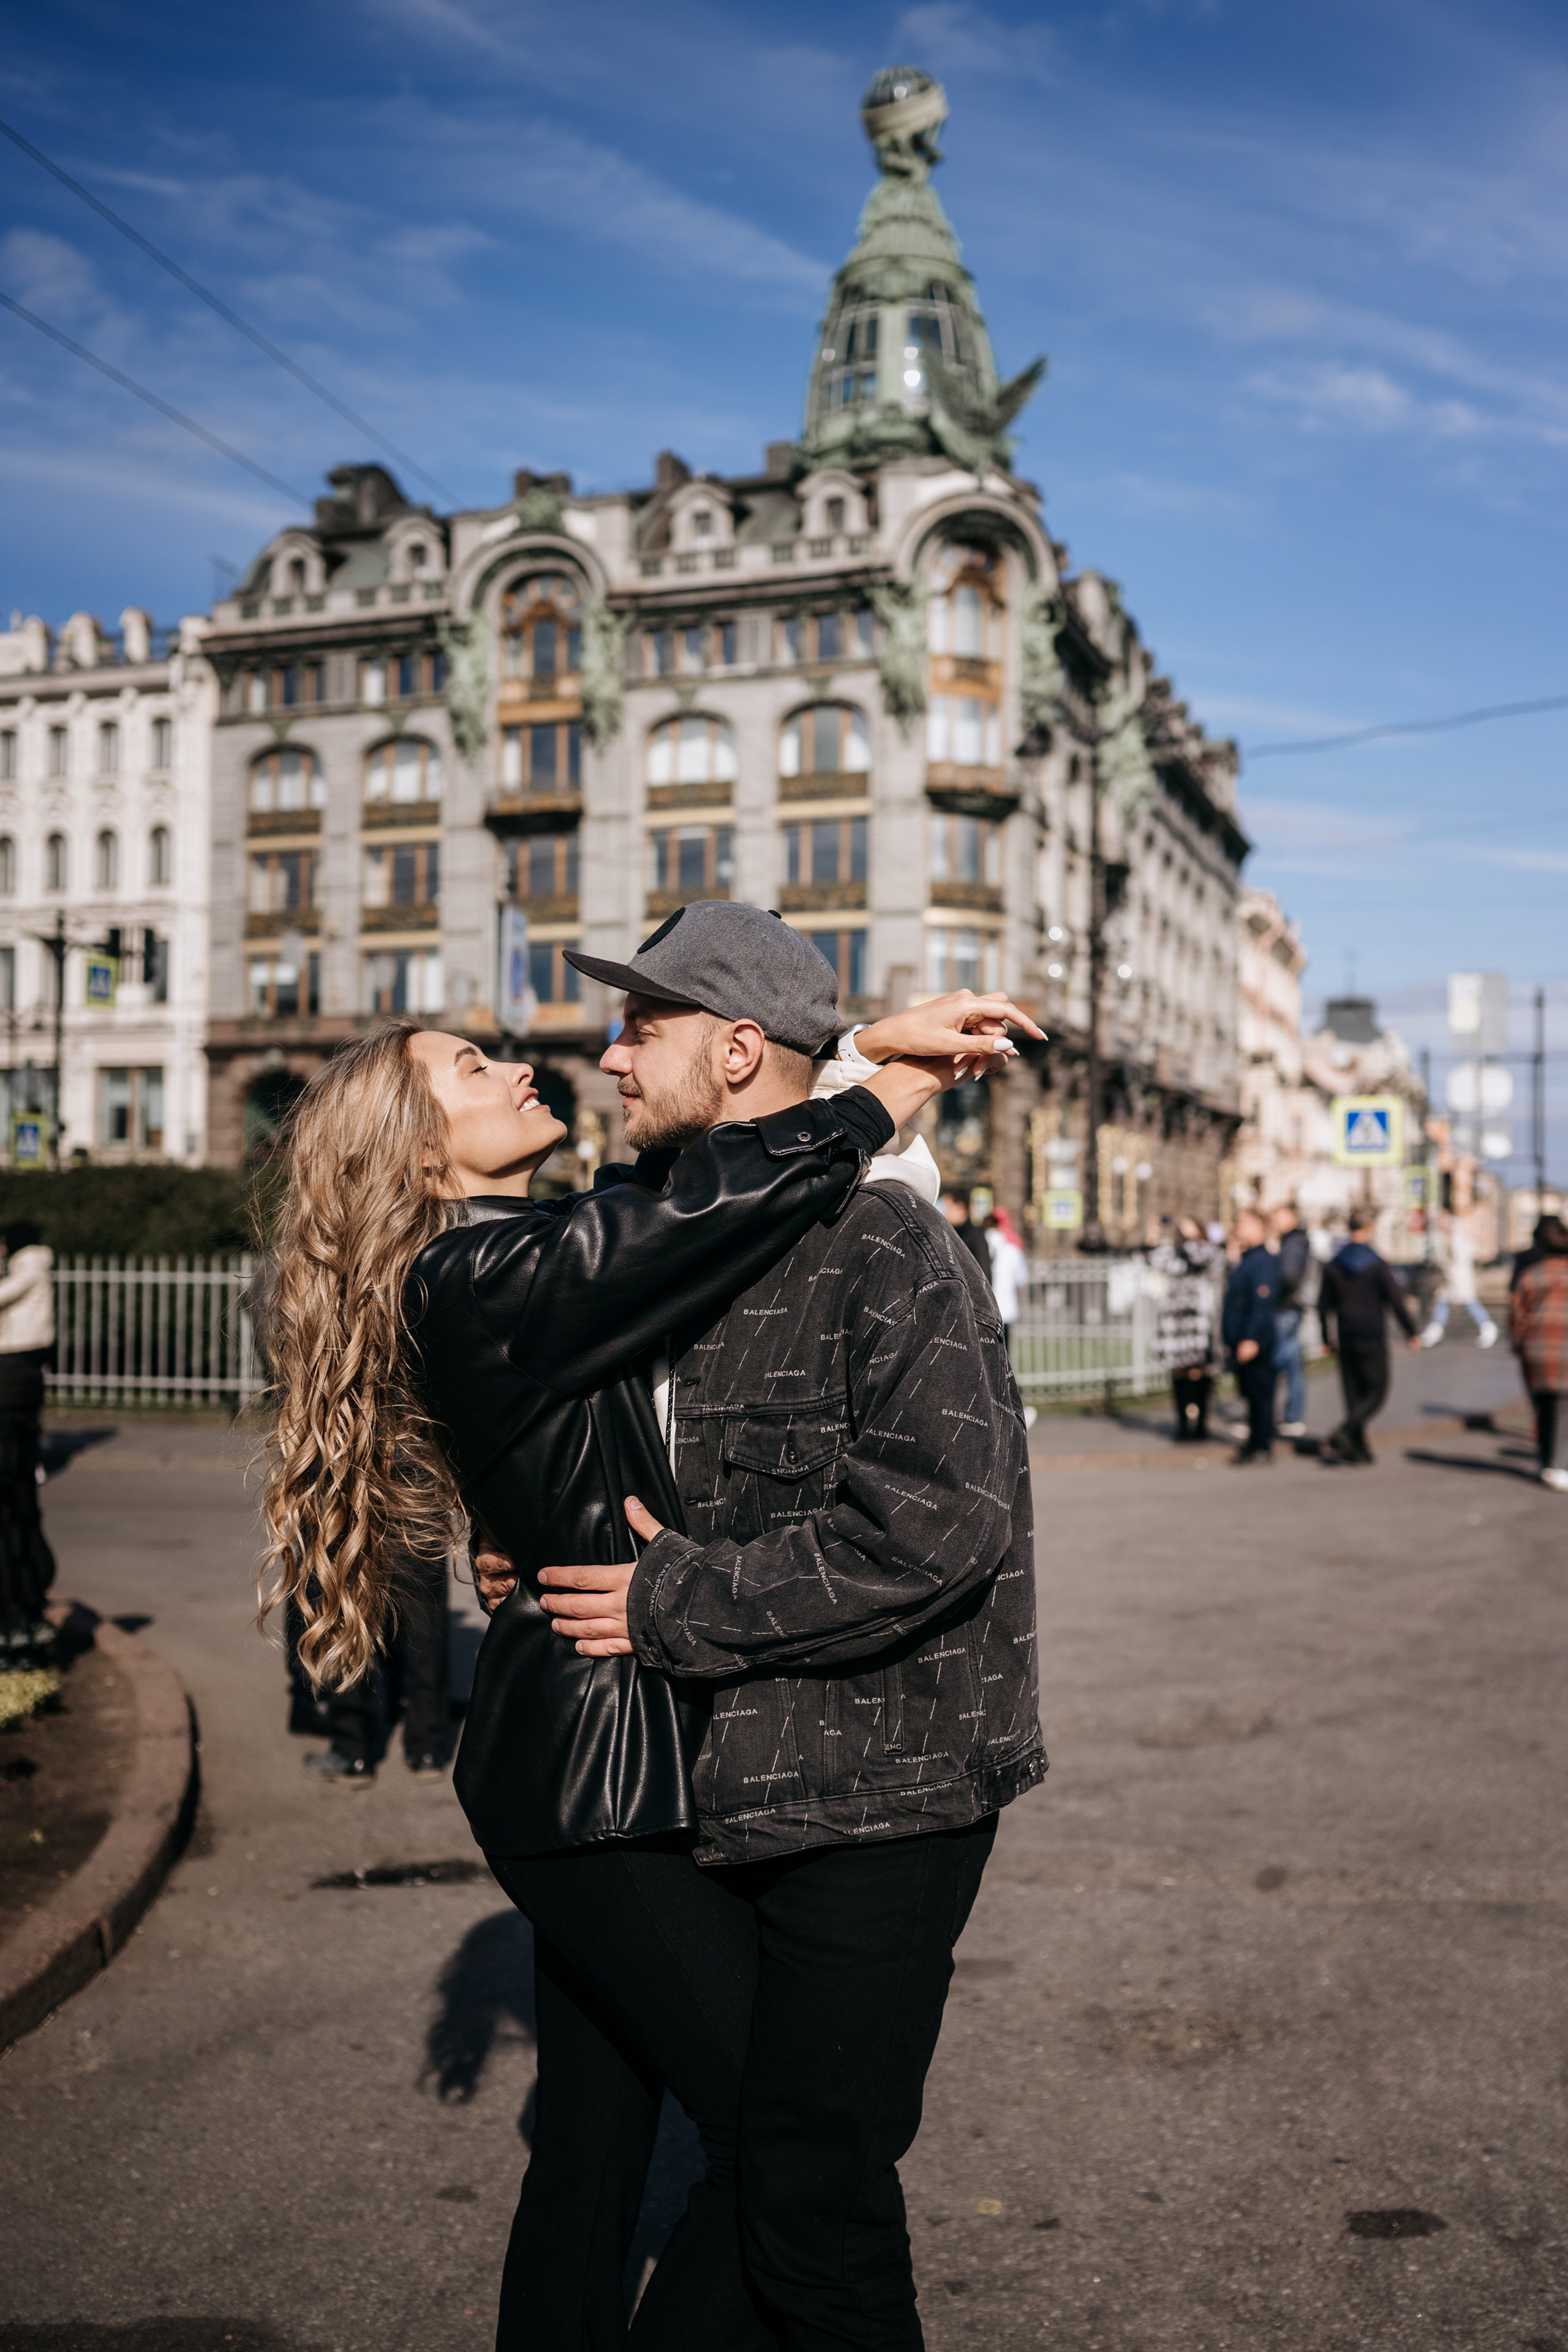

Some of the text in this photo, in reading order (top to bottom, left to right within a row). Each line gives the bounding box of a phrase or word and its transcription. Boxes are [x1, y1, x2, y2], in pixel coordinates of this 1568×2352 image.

[862, 1234, 905, 1259] BALENCIAGA
[941, 1409, 988, 1427] BALENCIAGA
[884, 1484, 938, 1510] BALENCIAGA
[732, 1556, 742, 1600] BALENCIAGA
[814, 1553, 838, 1604] BALENCIAGA
[892, 1556, 943, 1586] BALENCIAGA
[918, 1648, 966, 1663] BALENCIAGA
[895, 1752, 949, 1763] BALENCIAGA
[744, 1772, 799, 1784] BALENCIAGA
[725, 1809, 776, 1824] BALENCIAGA
